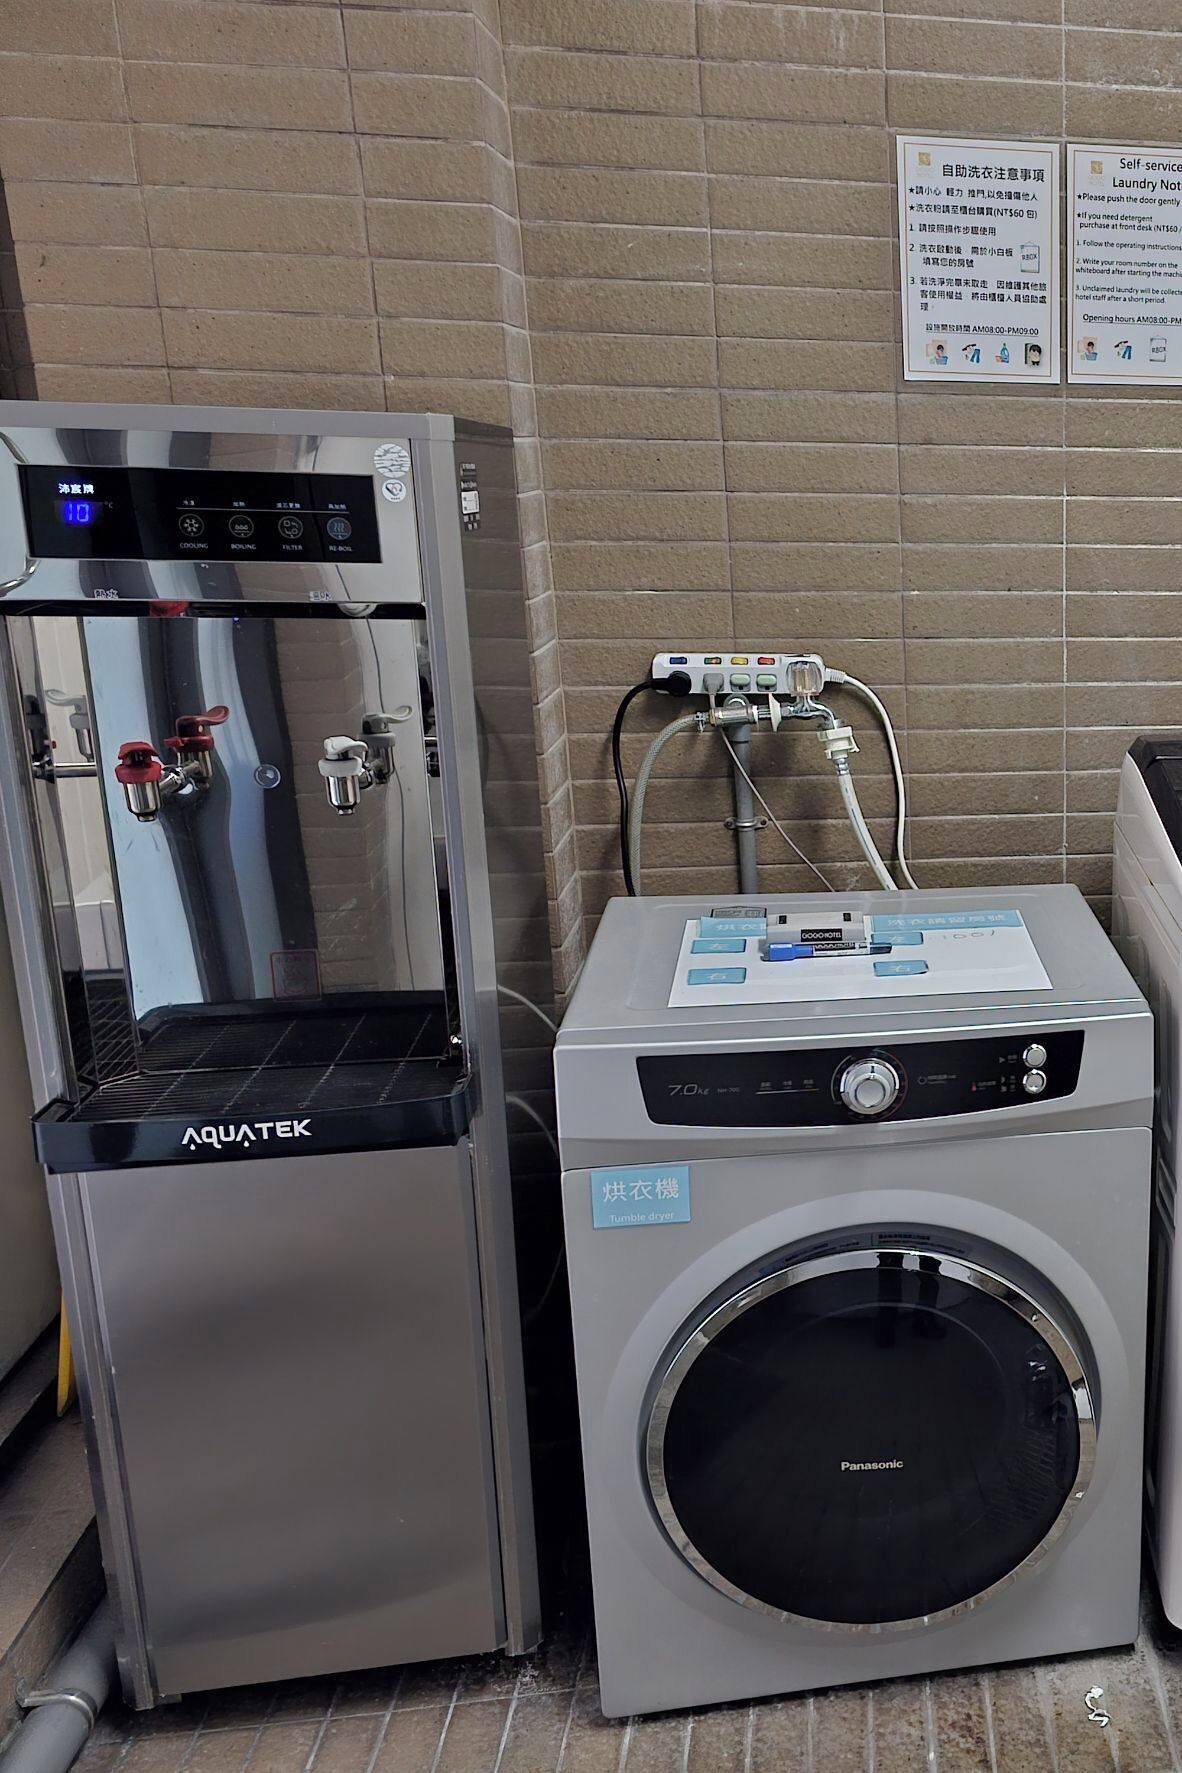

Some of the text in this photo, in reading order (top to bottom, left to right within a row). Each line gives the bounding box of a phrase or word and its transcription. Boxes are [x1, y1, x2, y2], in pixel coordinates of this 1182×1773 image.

[942, 164, 1045, 182] 自助洗衣注意事項
[1113, 177, 1157, 192] Laundry
[1107, 194, 1125, 204] push
[1126, 195, 1138, 203] the
[1139, 196, 1156, 204] door
[1158, 197, 1181, 207] gently
[1088, 214, 1101, 222] you
[1120, 214, 1153, 223] detergent
[1079, 221, 1110, 230] purchase
[1119, 223, 1136, 231] front
[1137, 224, 1152, 232] desk
[1115, 242, 1146, 251] operating
[1075, 267, 1111, 275] whiteboard
[1111, 268, 1126, 276] after
[1127, 269, 1151, 278] starting
[1115, 286, 1139, 295] laundry
[1082, 314, 1114, 323] Opening
[1114, 314, 1136, 323] hours
[972, 326, 1039, 336] AM08:00-PM09:00
[68, 503, 90, 522] 10
[181, 1119, 313, 1149] AQUATEK
[602, 1177, 680, 1203] 烘衣機
[609, 1211, 675, 1223] Tumble dryer
[841, 1459, 904, 1471] Panasonic
